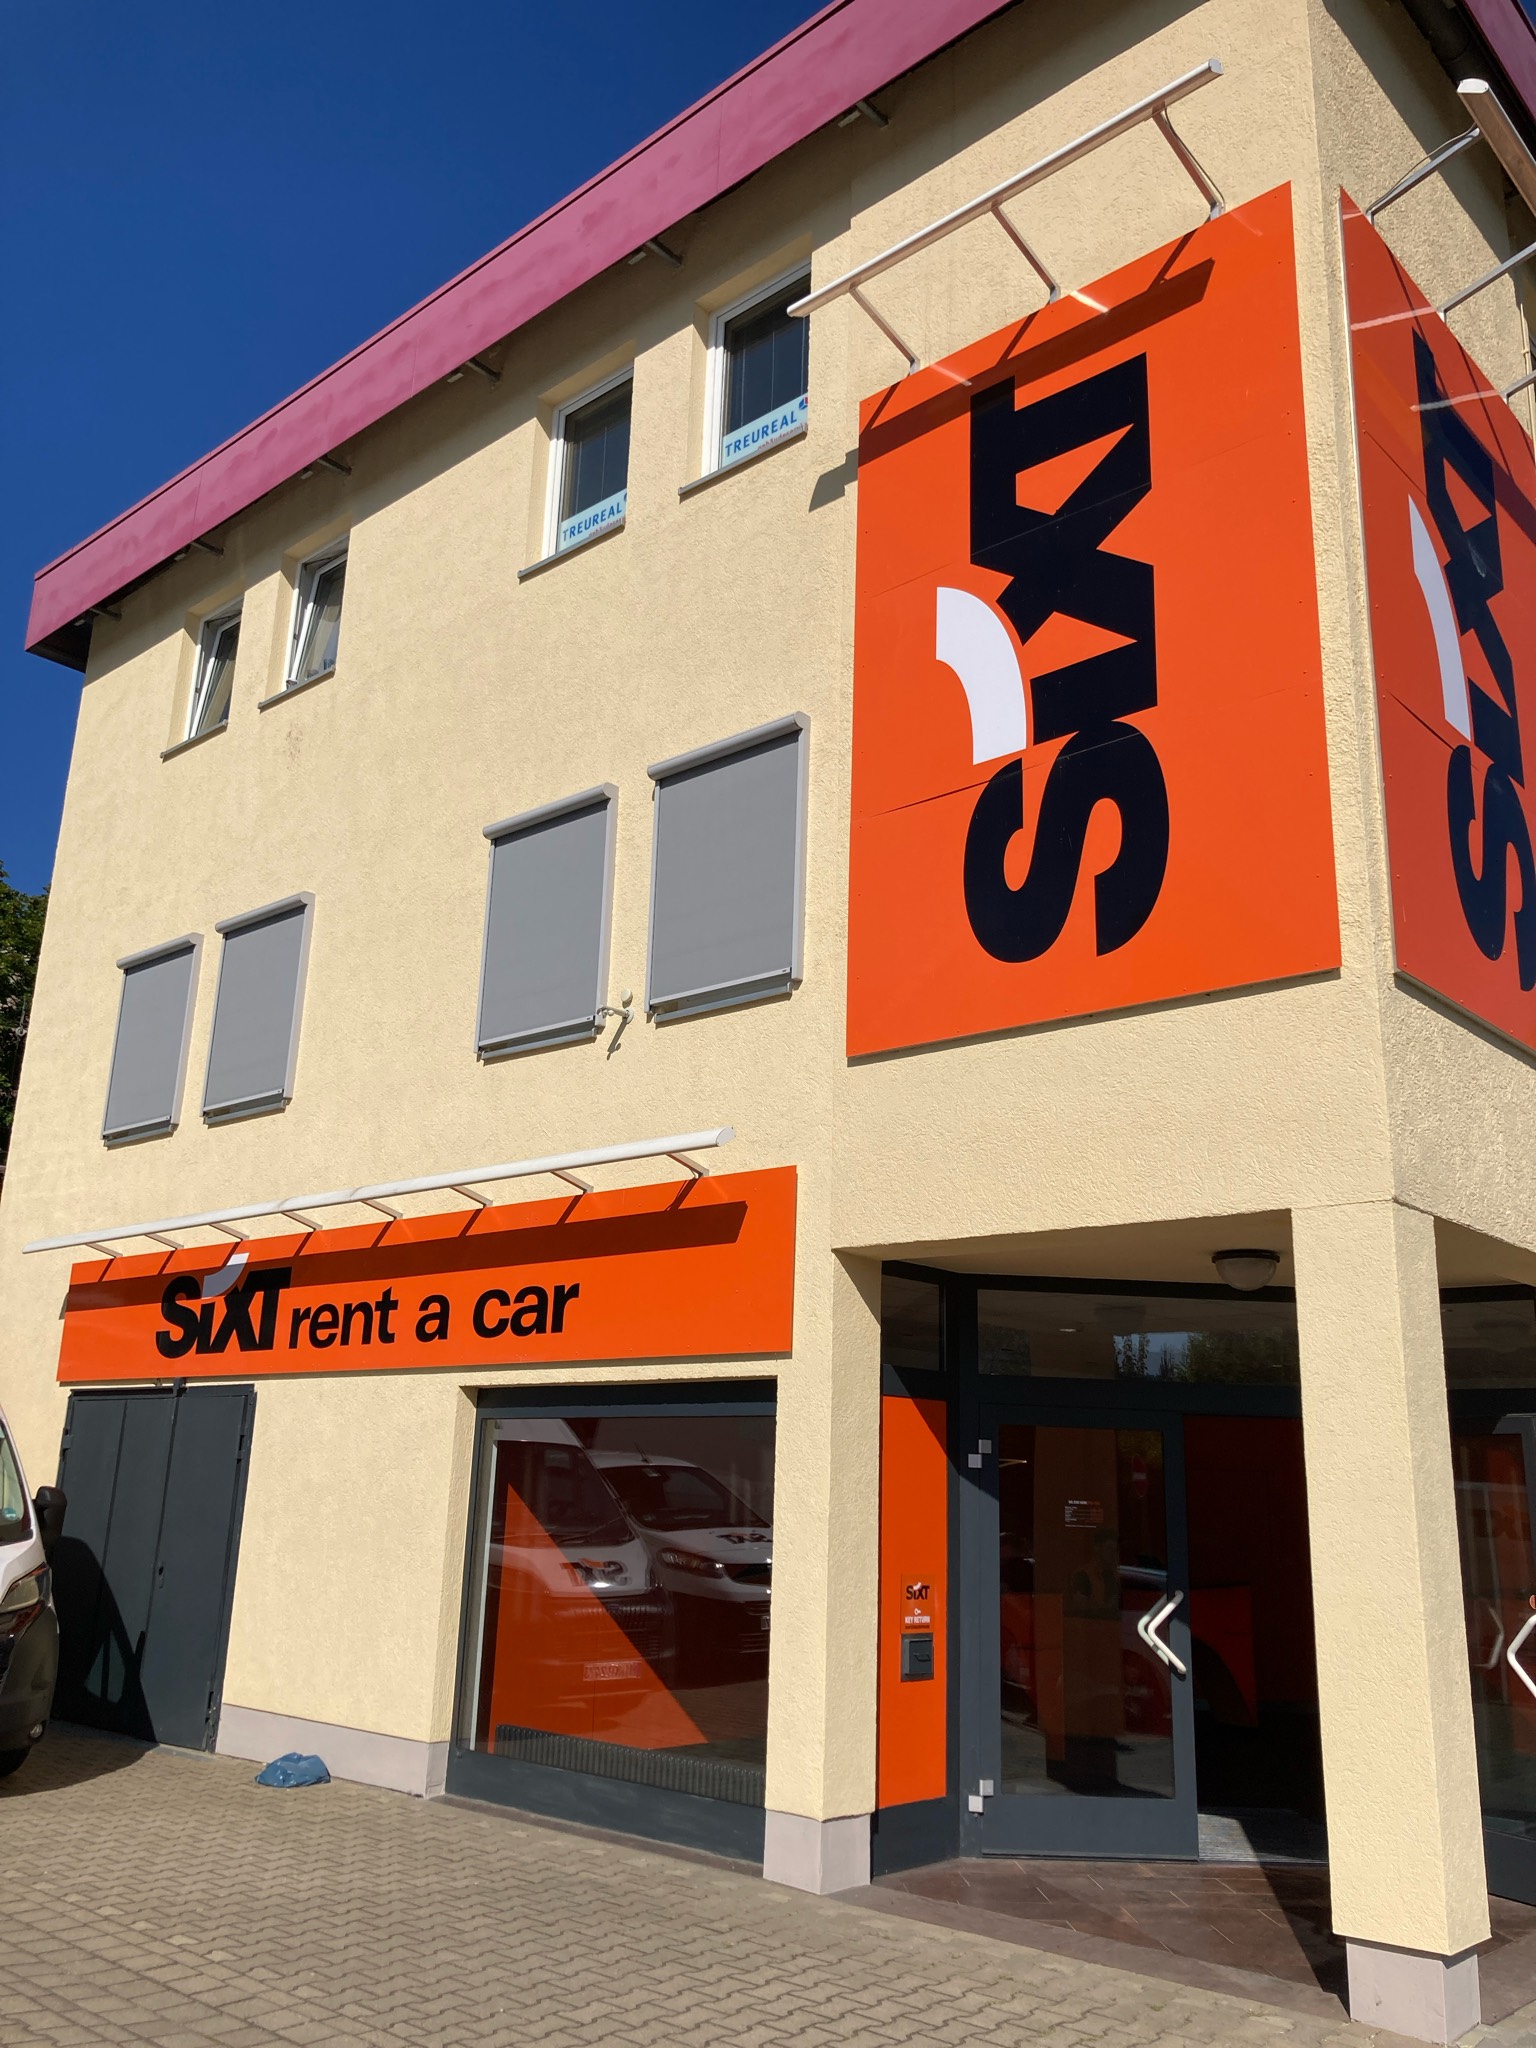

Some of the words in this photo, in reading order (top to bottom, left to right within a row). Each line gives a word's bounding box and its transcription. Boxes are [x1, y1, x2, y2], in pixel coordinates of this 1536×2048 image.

[725, 411, 797, 457] TREUREAL
[562, 502, 622, 541] TREUREAL
[936, 352, 1169, 963] SIXT
[155, 1252, 291, 1359] SIXT
[289, 1286, 397, 1350] rent
[414, 1297, 449, 1342] a
[472, 1283, 581, 1337] car
